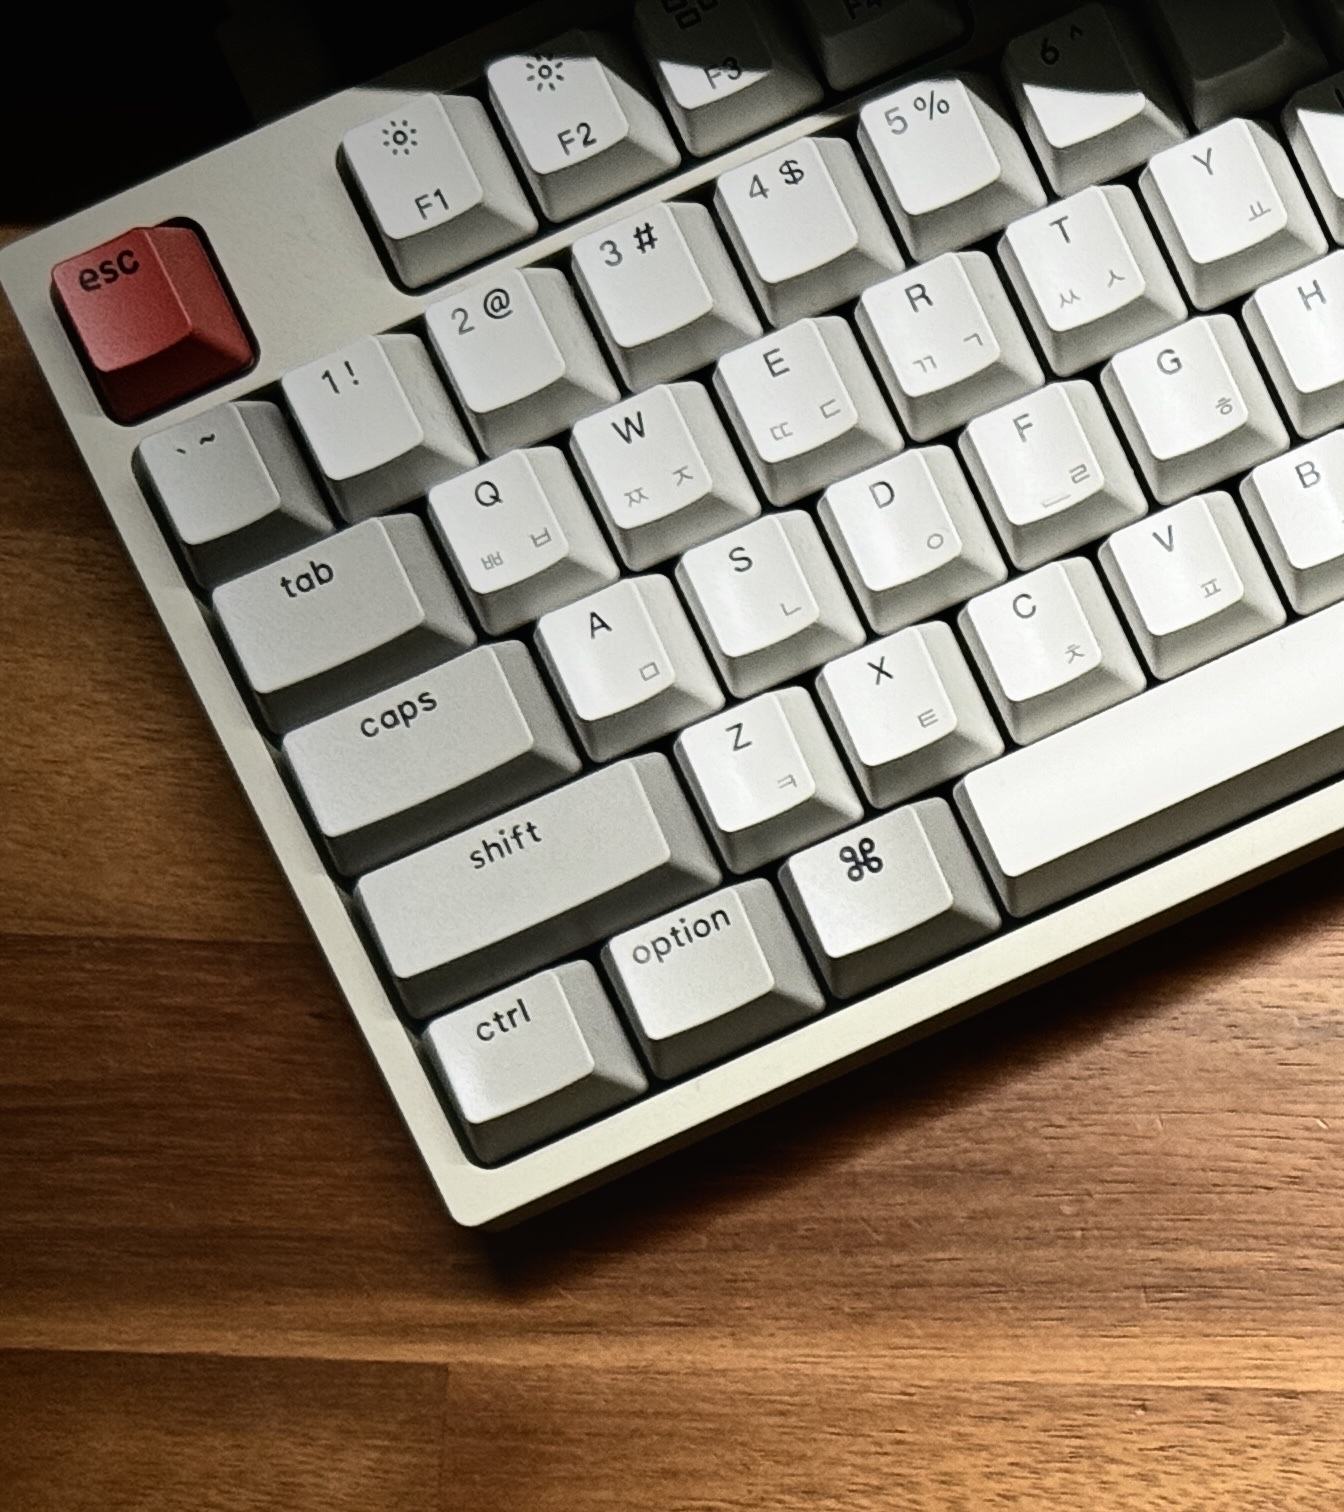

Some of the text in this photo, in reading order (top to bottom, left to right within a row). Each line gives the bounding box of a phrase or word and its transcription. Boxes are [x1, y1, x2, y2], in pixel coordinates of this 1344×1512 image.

[702, 54, 744, 91] F3
[558, 122, 597, 156] F2
[1193, 148, 1213, 175] Y
[414, 188, 450, 220] F1
[1249, 202, 1271, 221] ㅛ
[1050, 216, 1069, 243] T
[80, 250, 139, 291] esc
[1108, 270, 1125, 287] ㅅ
[905, 284, 932, 311] R
[1298, 280, 1326, 310] H
[964, 333, 983, 346] ㄱ
[763, 349, 789, 377] E
[1157, 349, 1181, 374] G
[820, 399, 841, 419] ㄷ
[1216, 397, 1232, 415] ㅎ
[612, 412, 644, 443] W
[1013, 413, 1033, 442] F
[673, 466, 693, 486] ㅈ
[1070, 464, 1090, 484] ㄹ
[1295, 461, 1319, 488] B
[475, 481, 501, 506] Q
[869, 480, 895, 509] D
[530, 528, 551, 547] ㅂ
[1153, 525, 1173, 552] V
[729, 547, 752, 572] S
[280, 560, 334, 599] tab
[1201, 578, 1221, 598] ㅍ
[781, 604, 801, 616] ㄴ
[1013, 594, 1036, 618] C
[591, 612, 611, 637] A
[639, 662, 660, 681] ㅁ
[868, 657, 892, 684] X
[360, 690, 438, 738] caps
[918, 709, 938, 728] ㅌ
[726, 723, 751, 751] Z
[778, 774, 797, 788] ㅋ
[469, 820, 543, 870] shift
[631, 905, 732, 966] option
[475, 997, 531, 1042] ctrl
